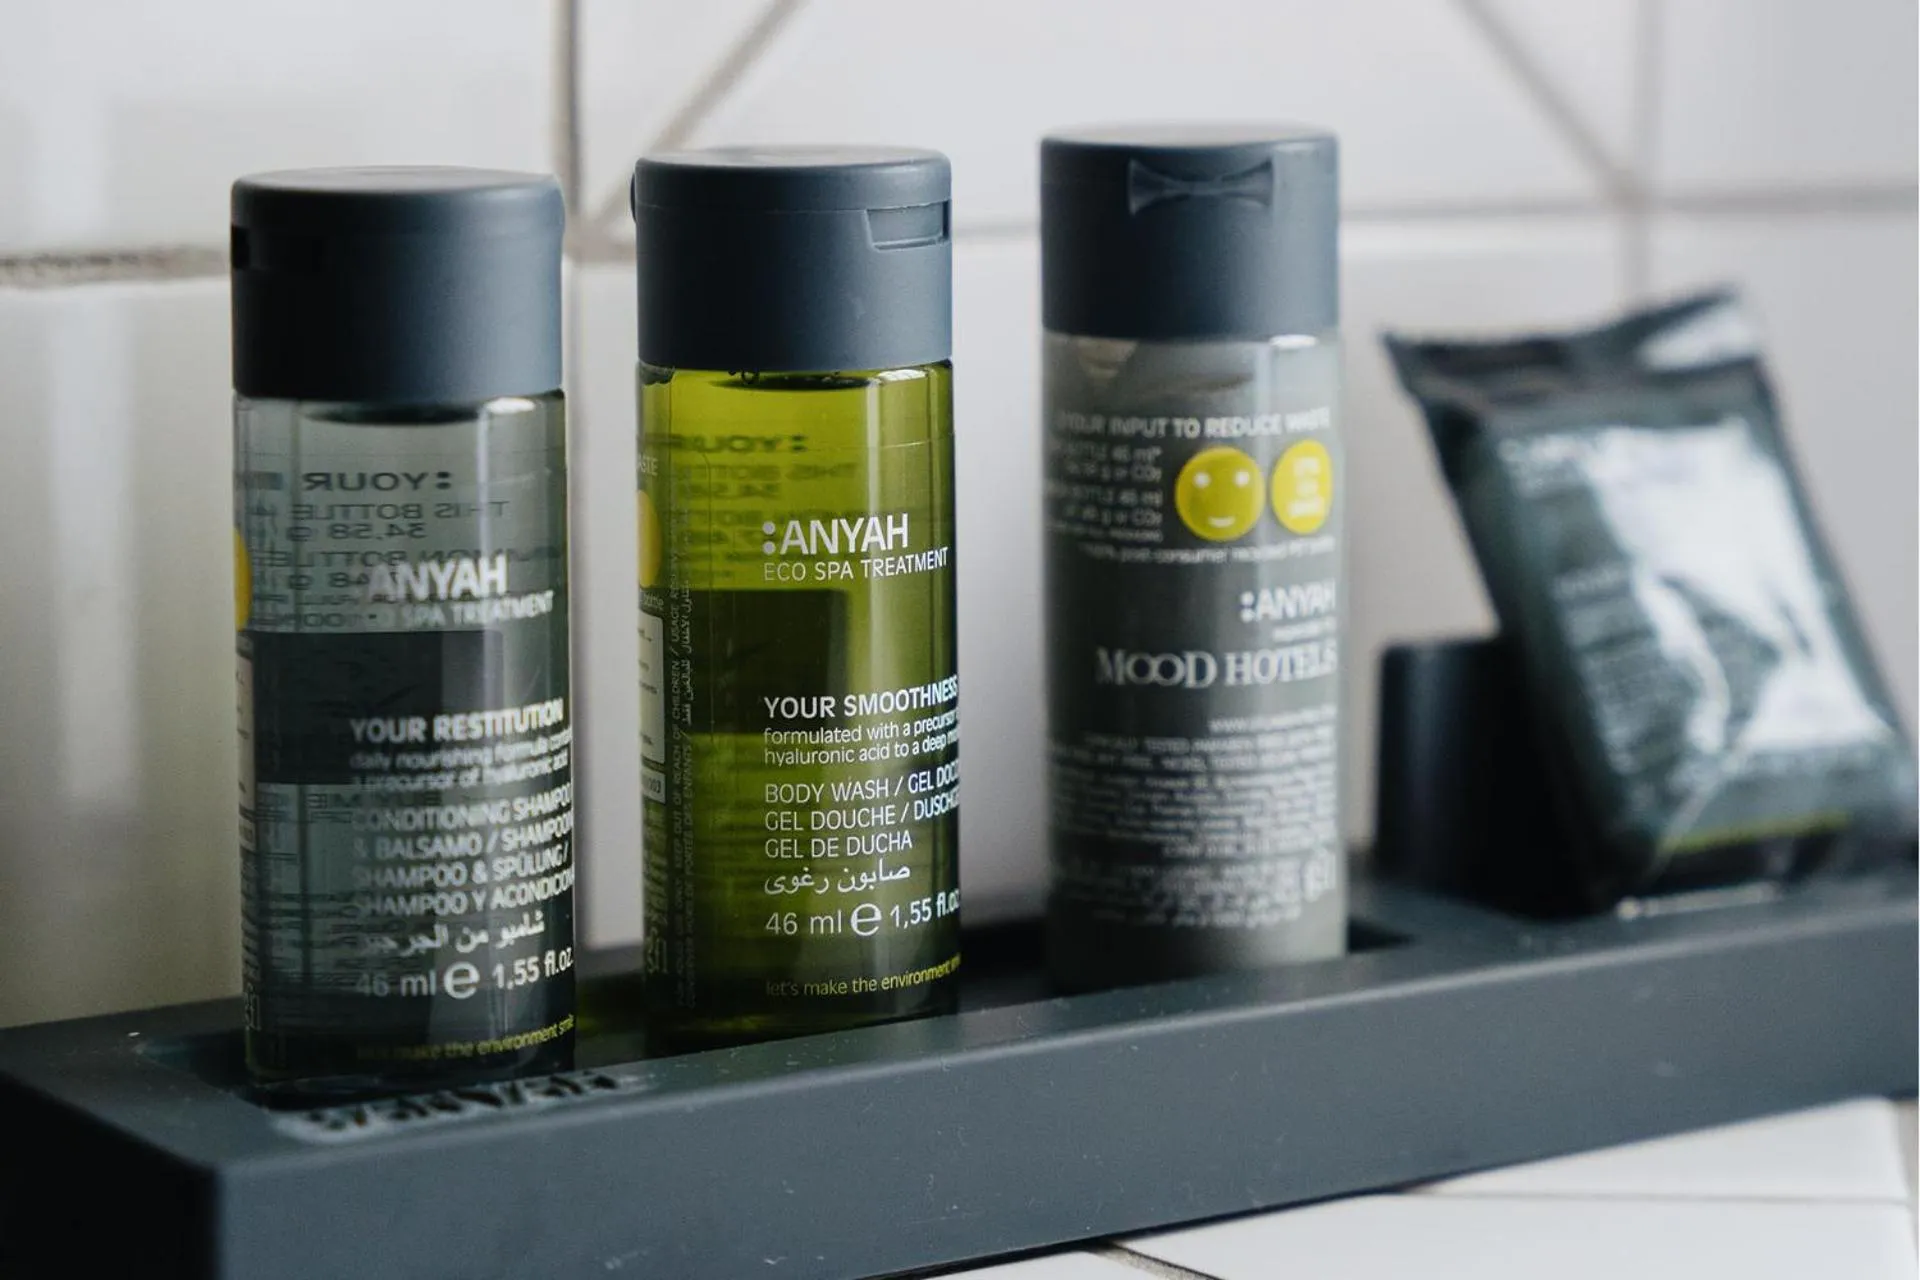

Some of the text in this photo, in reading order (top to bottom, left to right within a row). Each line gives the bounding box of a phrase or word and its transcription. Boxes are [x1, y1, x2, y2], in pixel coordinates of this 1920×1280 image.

[1171, 417, 1200, 438] TO
[763, 513, 909, 555] :ANYAH
[764, 546, 949, 582] ECO SPA TREATMENT
[1096, 648, 1217, 689] MOOD
[764, 674, 958, 719] YOUR SMOOTHNESS
[350, 697, 564, 743] YOUR RESTITUTION
[764, 726, 861, 744] formulated
[867, 721, 899, 740] with
[903, 723, 911, 737] a
[764, 747, 854, 766] hyaluronic
[859, 741, 889, 760] acid
[894, 740, 909, 757] to
[912, 741, 920, 755] a
[922, 733, 946, 754] deep
[765, 783, 825, 805] BODY
[831, 777, 888, 800] WASH
[894, 776, 904, 797] /
[908, 771, 934, 794] GEL
[765, 811, 803, 832] GEL
[811, 807, 896, 831] DOUCHE
[901, 802, 910, 823] /
[376, 832, 482, 861] BALSAMO
[765, 830, 913, 859] GEL DE DUCHA
[353, 862, 468, 889] SHAMPOO
[472, 860, 488, 884] &
[837, 859, 910, 892] صابون
[471, 888, 486, 911] Y
[765, 912, 798, 935] 46
[810, 909, 842, 935] ml
[889, 897, 932, 930] 1,55
[356, 971, 390, 997] 46
[401, 969, 436, 997] ml
[492, 956, 540, 990] 1,55
[803, 978, 848, 997] make
[852, 976, 877, 992] the
